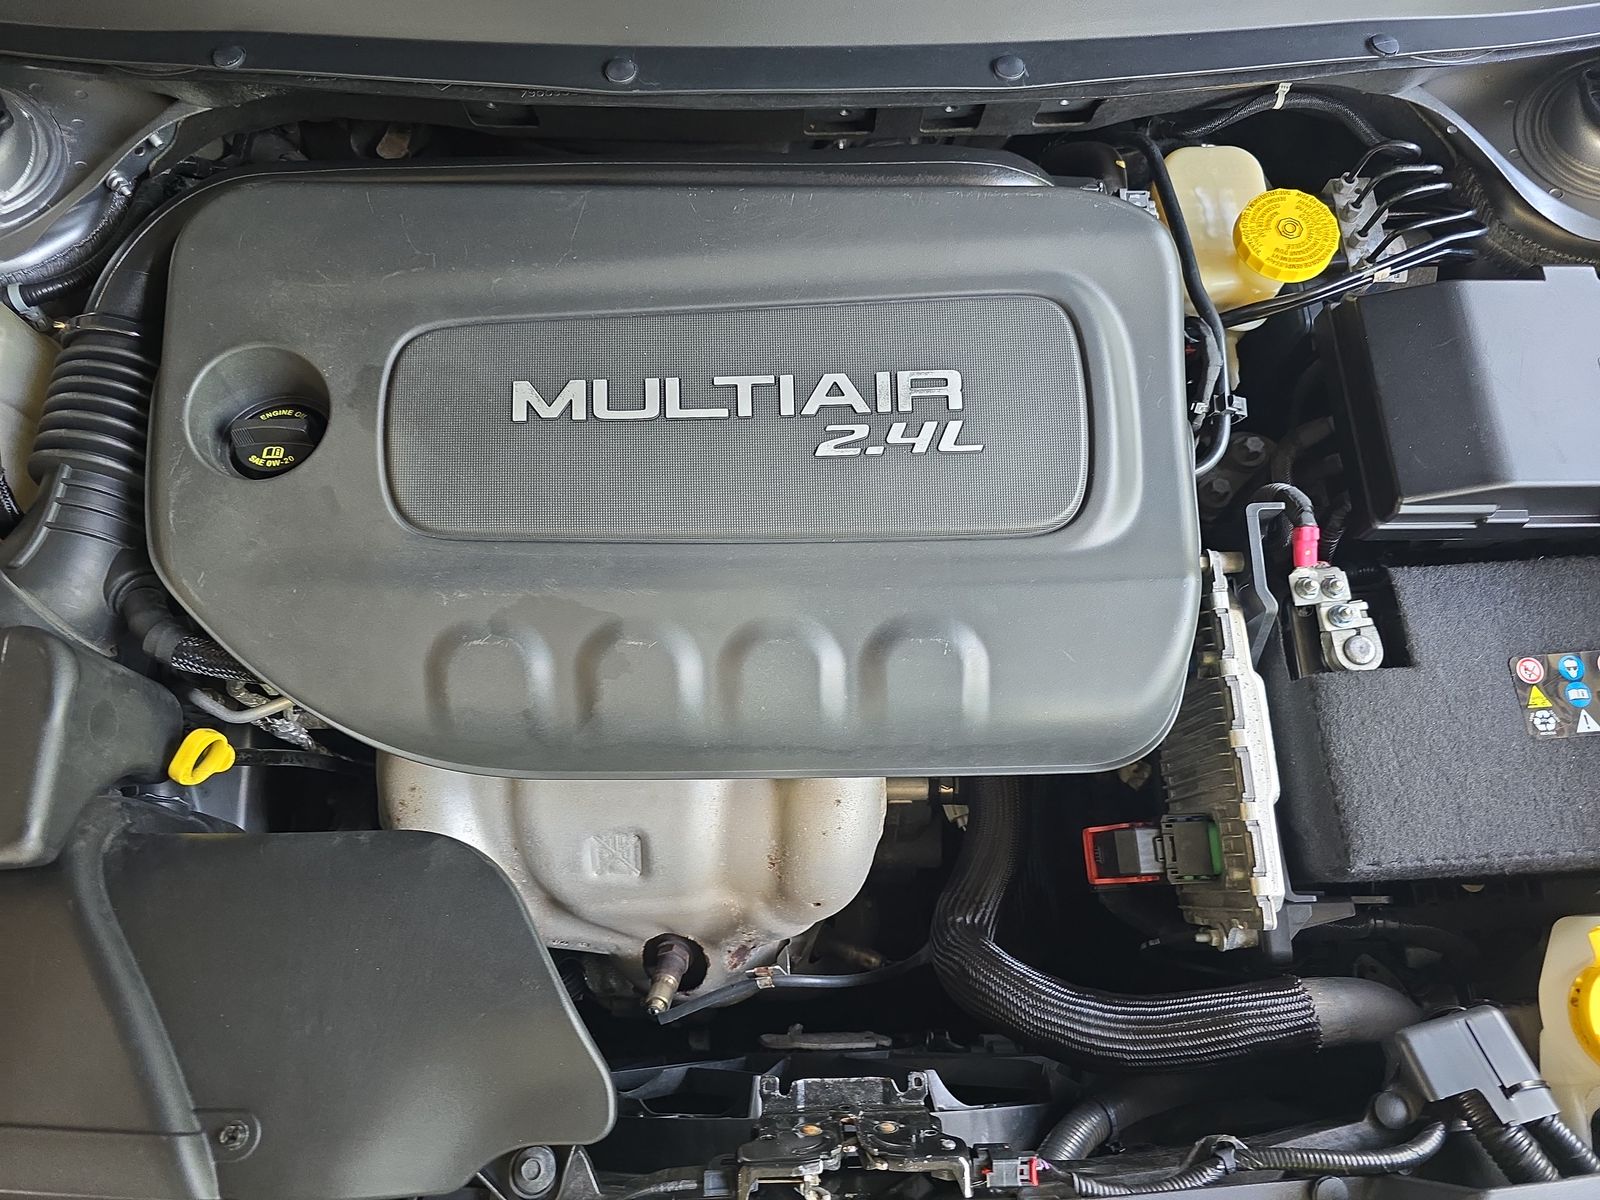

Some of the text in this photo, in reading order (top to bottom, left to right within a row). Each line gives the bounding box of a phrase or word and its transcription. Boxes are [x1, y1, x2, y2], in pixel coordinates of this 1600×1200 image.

[512, 369, 964, 422] MULTIAIR
[260, 409, 294, 421] ENGINE
[814, 420, 985, 457] 2.4L
[248, 455, 266, 467] SAE
